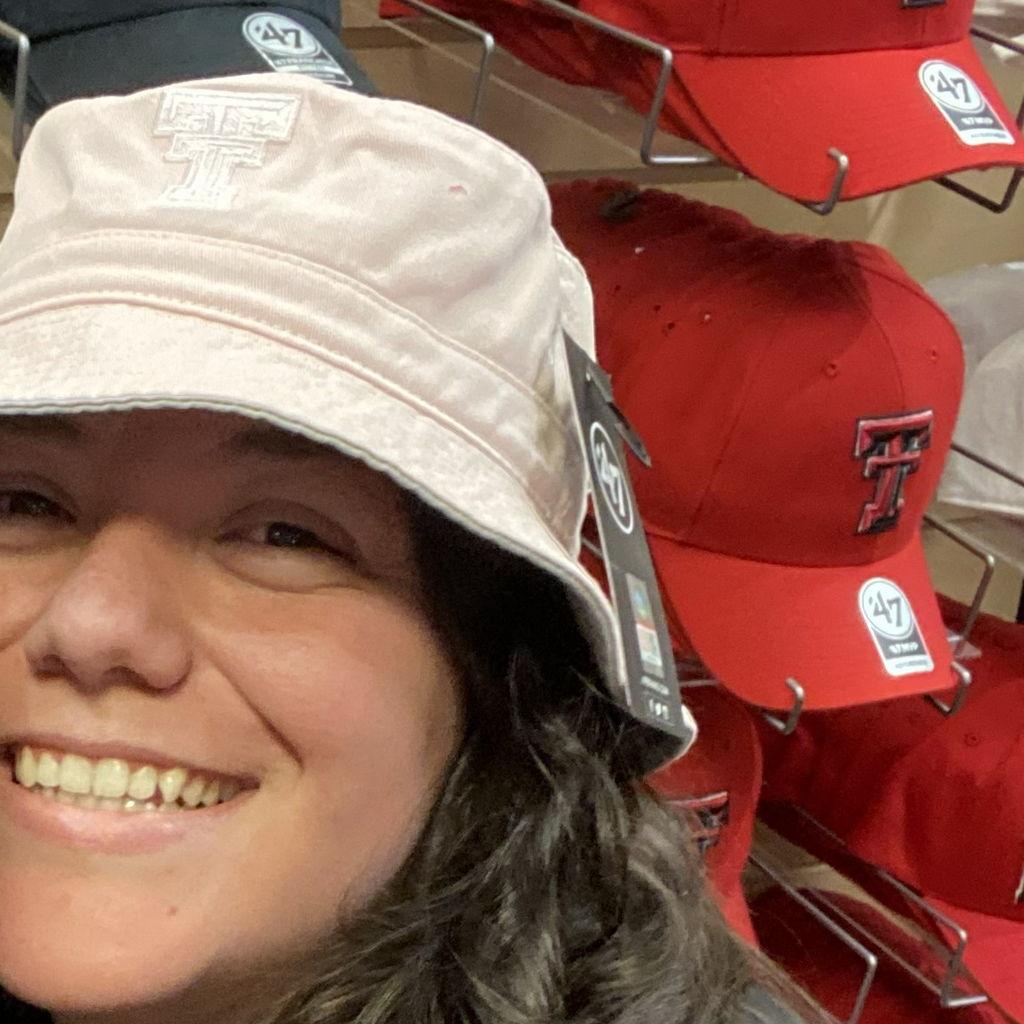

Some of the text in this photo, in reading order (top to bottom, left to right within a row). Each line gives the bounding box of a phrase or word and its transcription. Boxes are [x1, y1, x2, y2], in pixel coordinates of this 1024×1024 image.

[255, 22, 302, 49] '47
[930, 70, 972, 103] '47
[868, 591, 903, 628] '47
